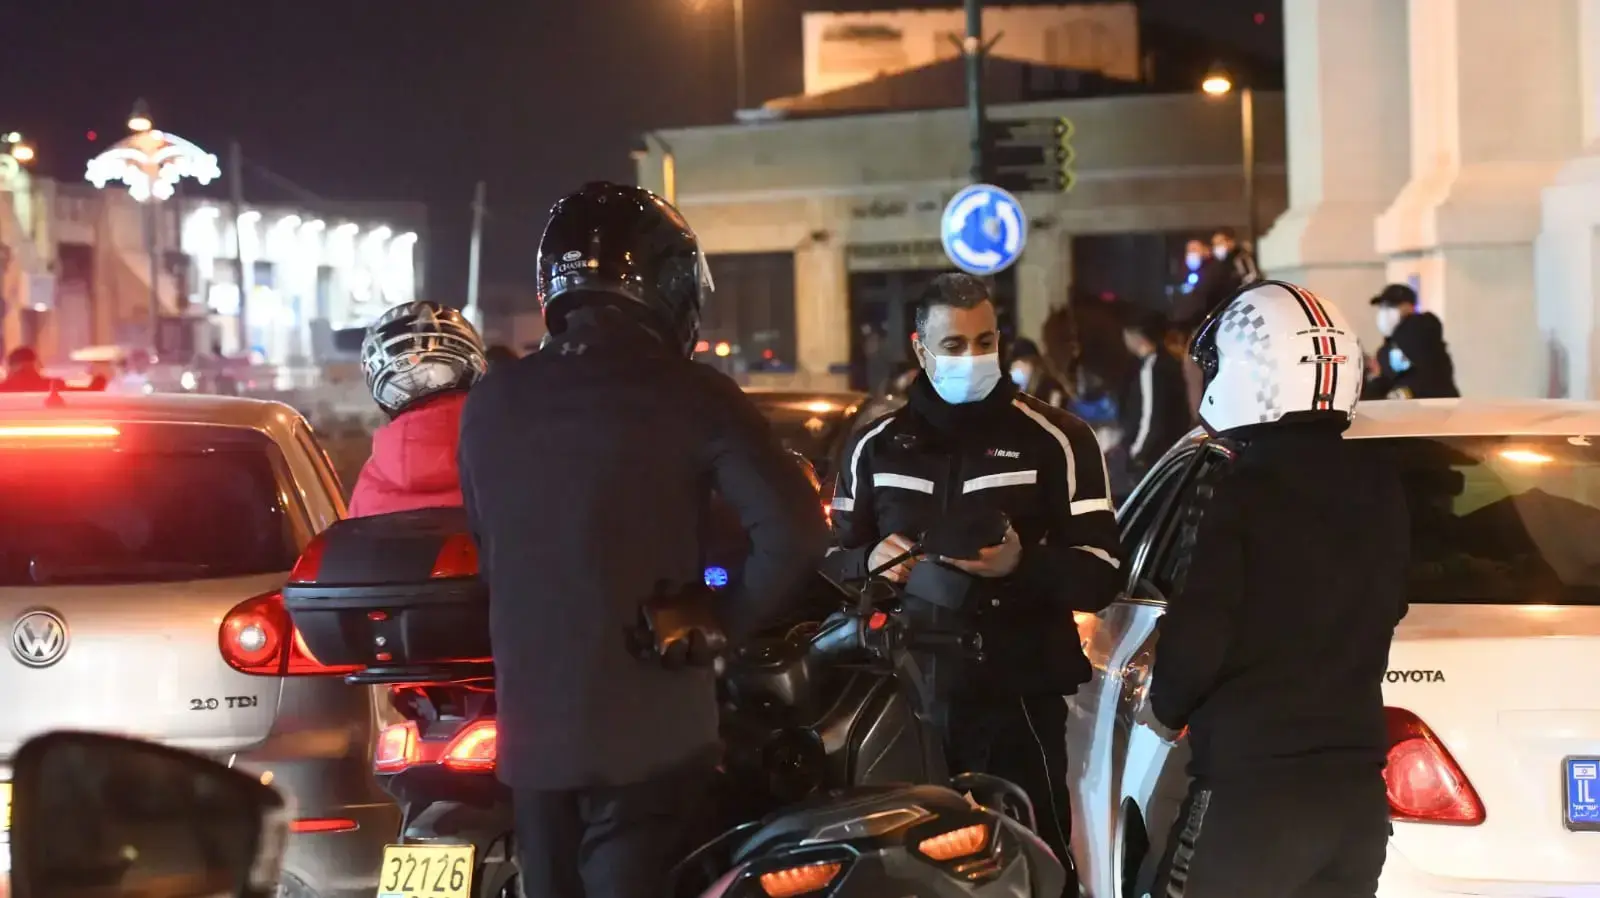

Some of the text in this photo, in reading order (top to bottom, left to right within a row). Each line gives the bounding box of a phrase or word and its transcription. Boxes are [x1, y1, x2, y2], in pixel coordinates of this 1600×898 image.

[1299, 355, 1347, 364] LS2
[1386, 670, 1445, 683] OYOTA
[1578, 780, 1595, 803] IL
[385, 856, 466, 892] 32126
